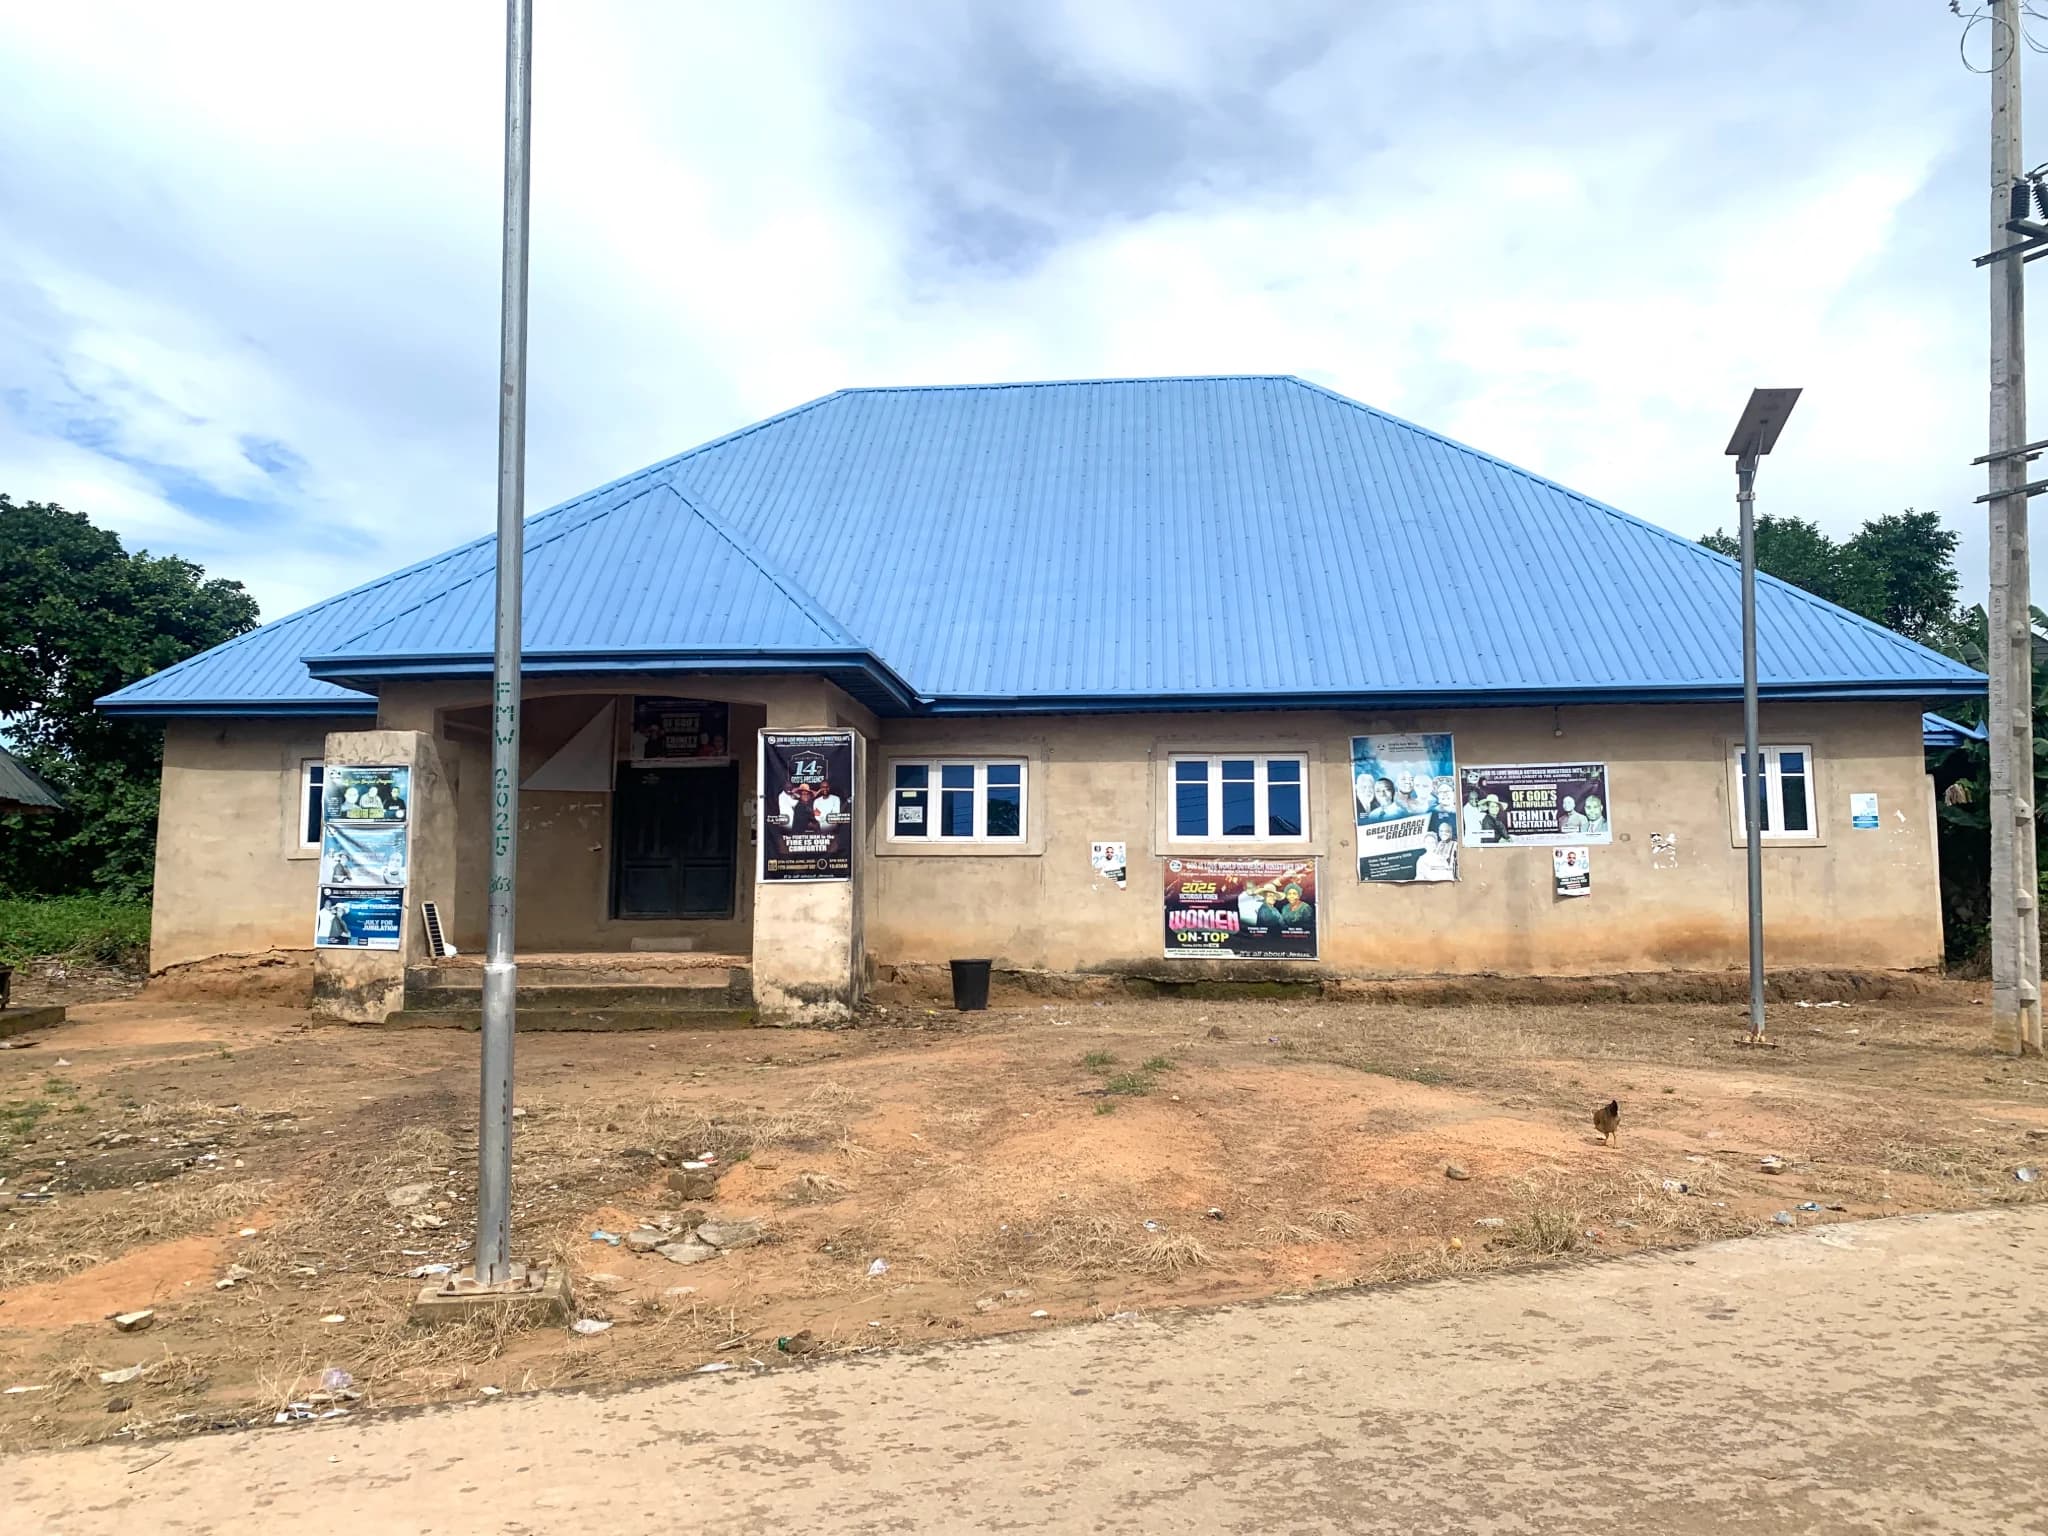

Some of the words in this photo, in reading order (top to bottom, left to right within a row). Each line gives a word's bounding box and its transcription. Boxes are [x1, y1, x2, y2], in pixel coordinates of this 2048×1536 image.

[495, 682, 515, 745] FMW
[1511, 790, 1525, 802] OF
[1526, 790, 1558, 801] GOD'S
[1512, 800, 1557, 809] FAITHFULNESS
[495, 768, 510, 857] 2025
[1510, 810, 1558, 821] TRINITY
[1366, 823, 1400, 836] GREATER
[1400, 818, 1425, 831] GRACE
[1512, 820, 1558, 828] VISITATION
[1385, 826, 1423, 840] GREATER
[1181, 882, 1217, 894] 2025
[1168, 909, 1239, 932] WOMEN
[1177, 931, 1230, 942] ON-TOP
